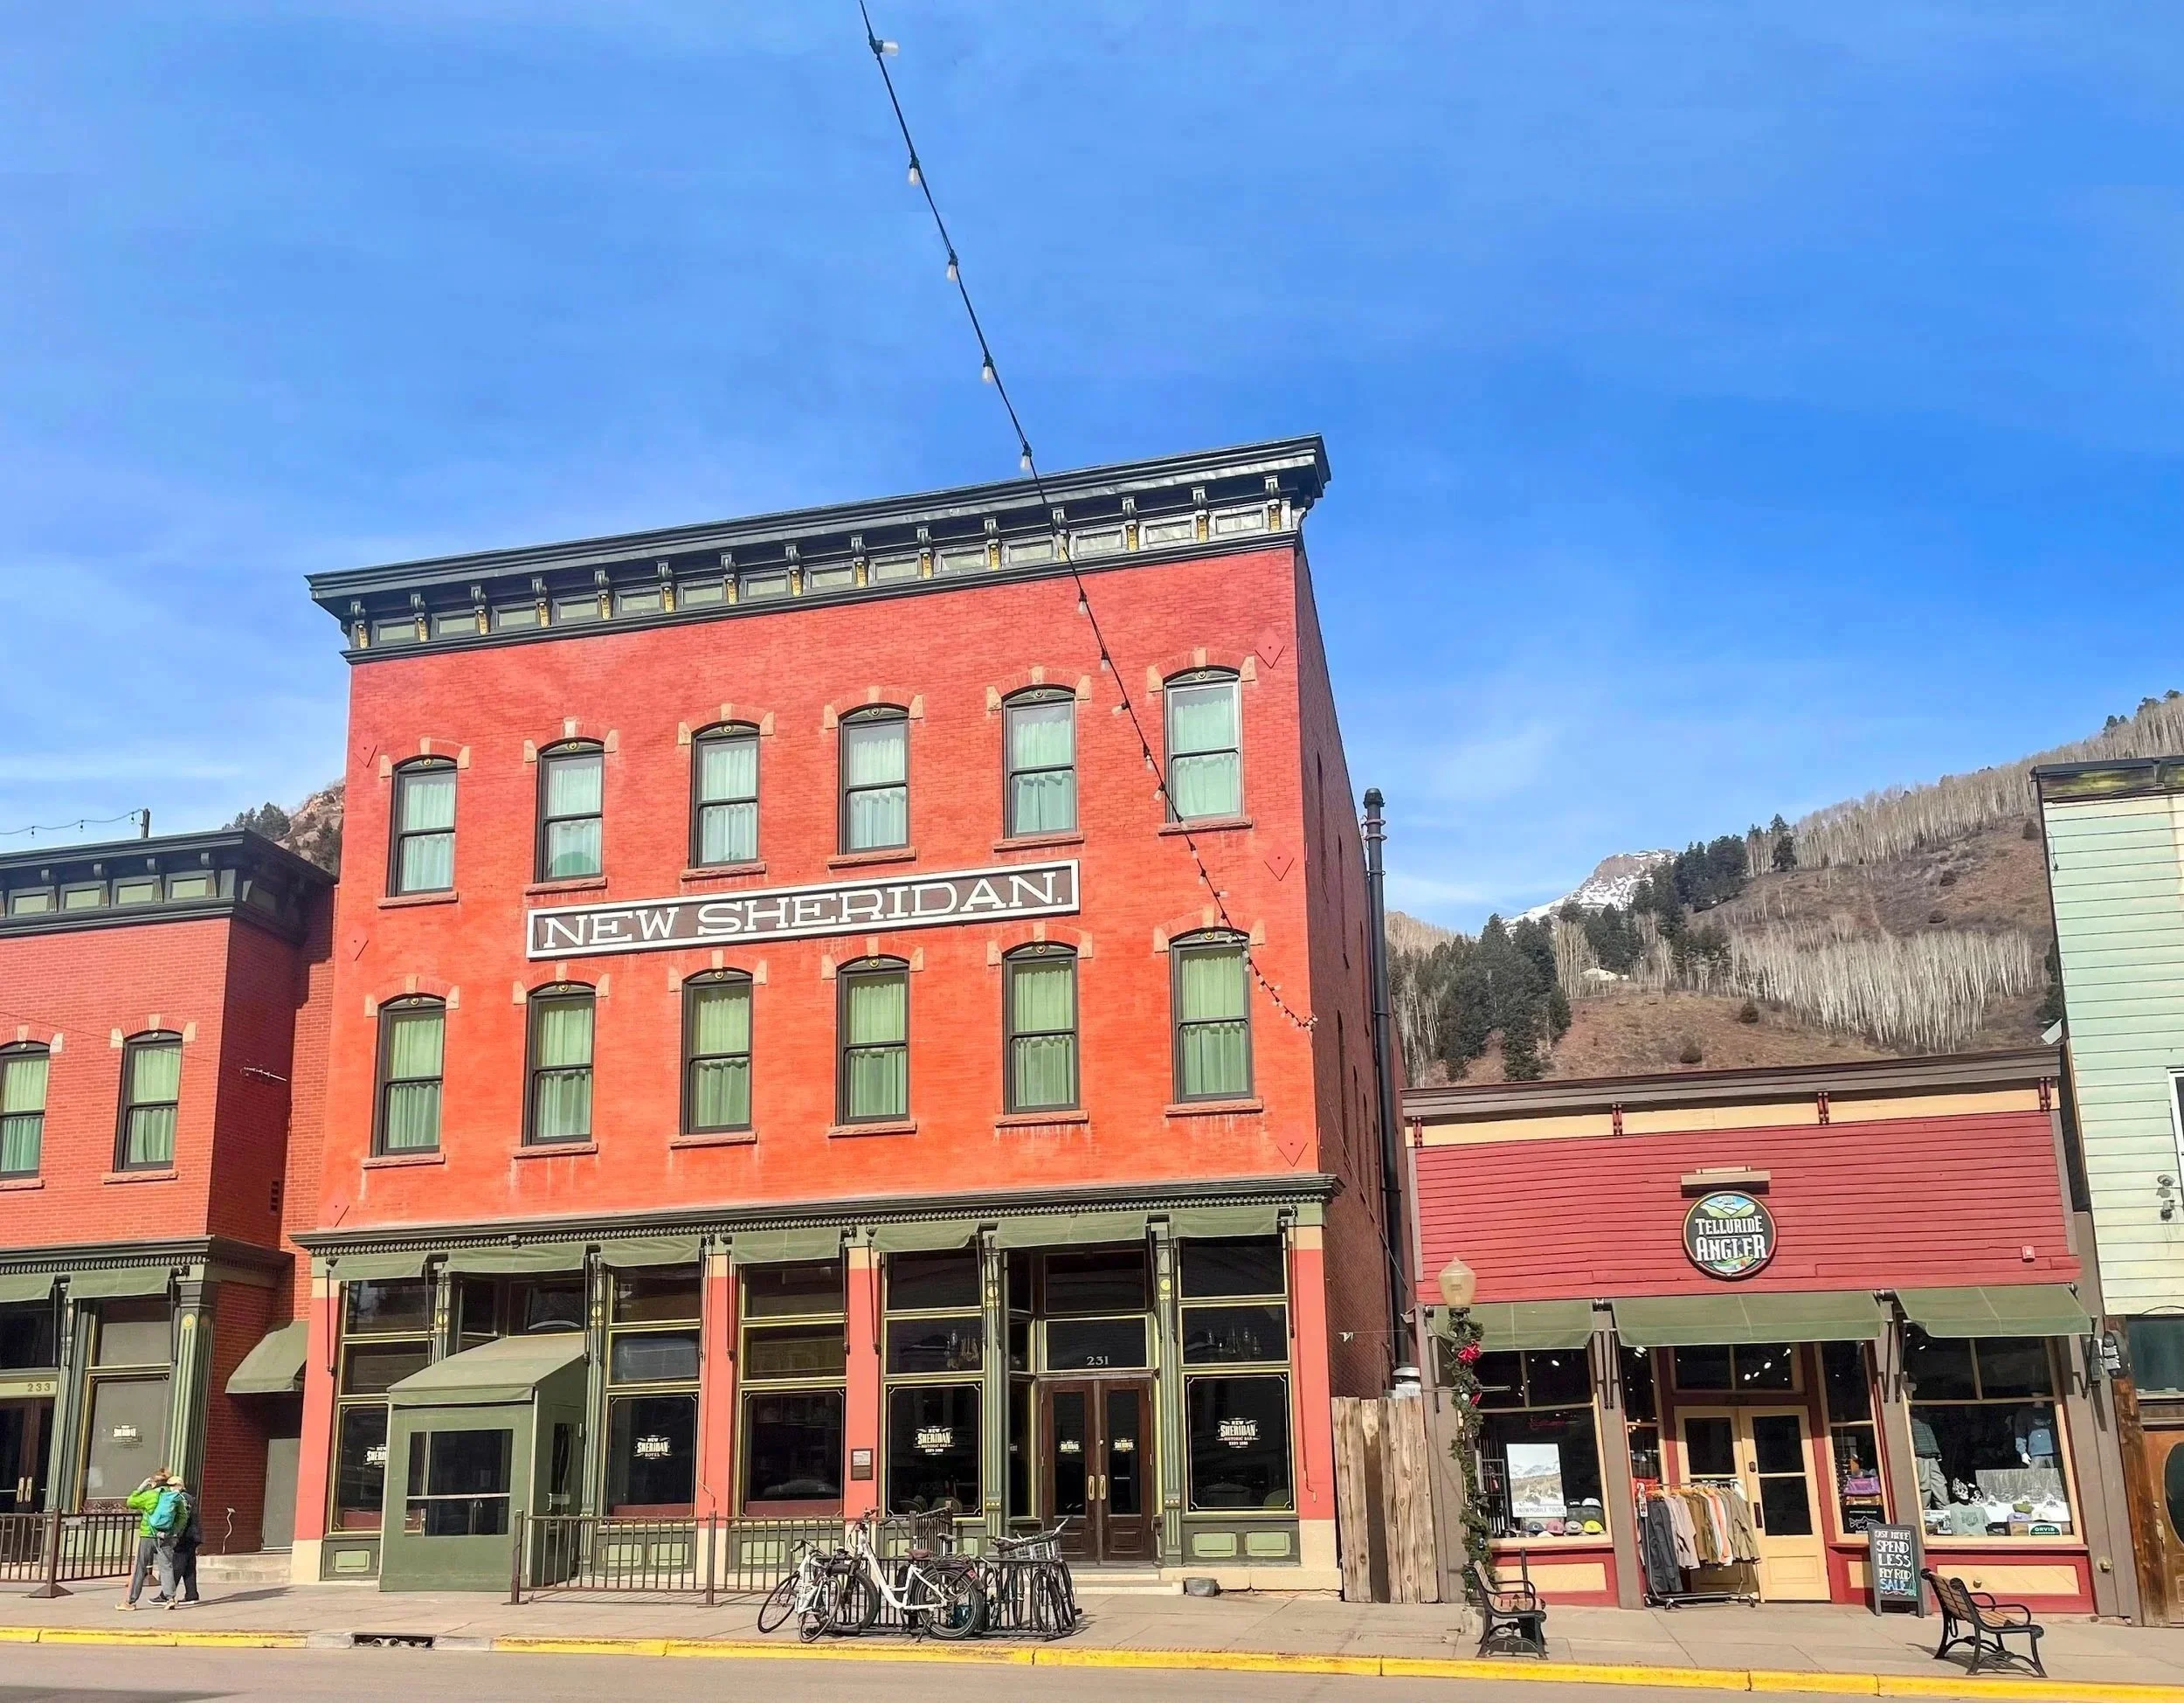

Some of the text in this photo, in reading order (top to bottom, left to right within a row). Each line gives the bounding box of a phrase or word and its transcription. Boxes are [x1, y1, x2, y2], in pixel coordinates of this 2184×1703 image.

[543, 906, 681, 949] NEW
[1695, 1215, 1764, 1236] TELLURIDE
[1696, 1234, 1767, 1263] ANGLER
[1086, 1355, 1109, 1366] 231
[27, 1383, 51, 1392] 233
[1220, 1424, 1256, 1437] SHERIDAN
[917, 1432, 951, 1444] SHERIDAN
[637, 1442, 668, 1453] SHERIDAN
[1876, 1540, 1910, 1554] SPEND
[1877, 1554, 1911, 1568] LESS
[1879, 1568, 1911, 1582] FLY ROD
[1879, 1578, 1910, 1591] SALE
